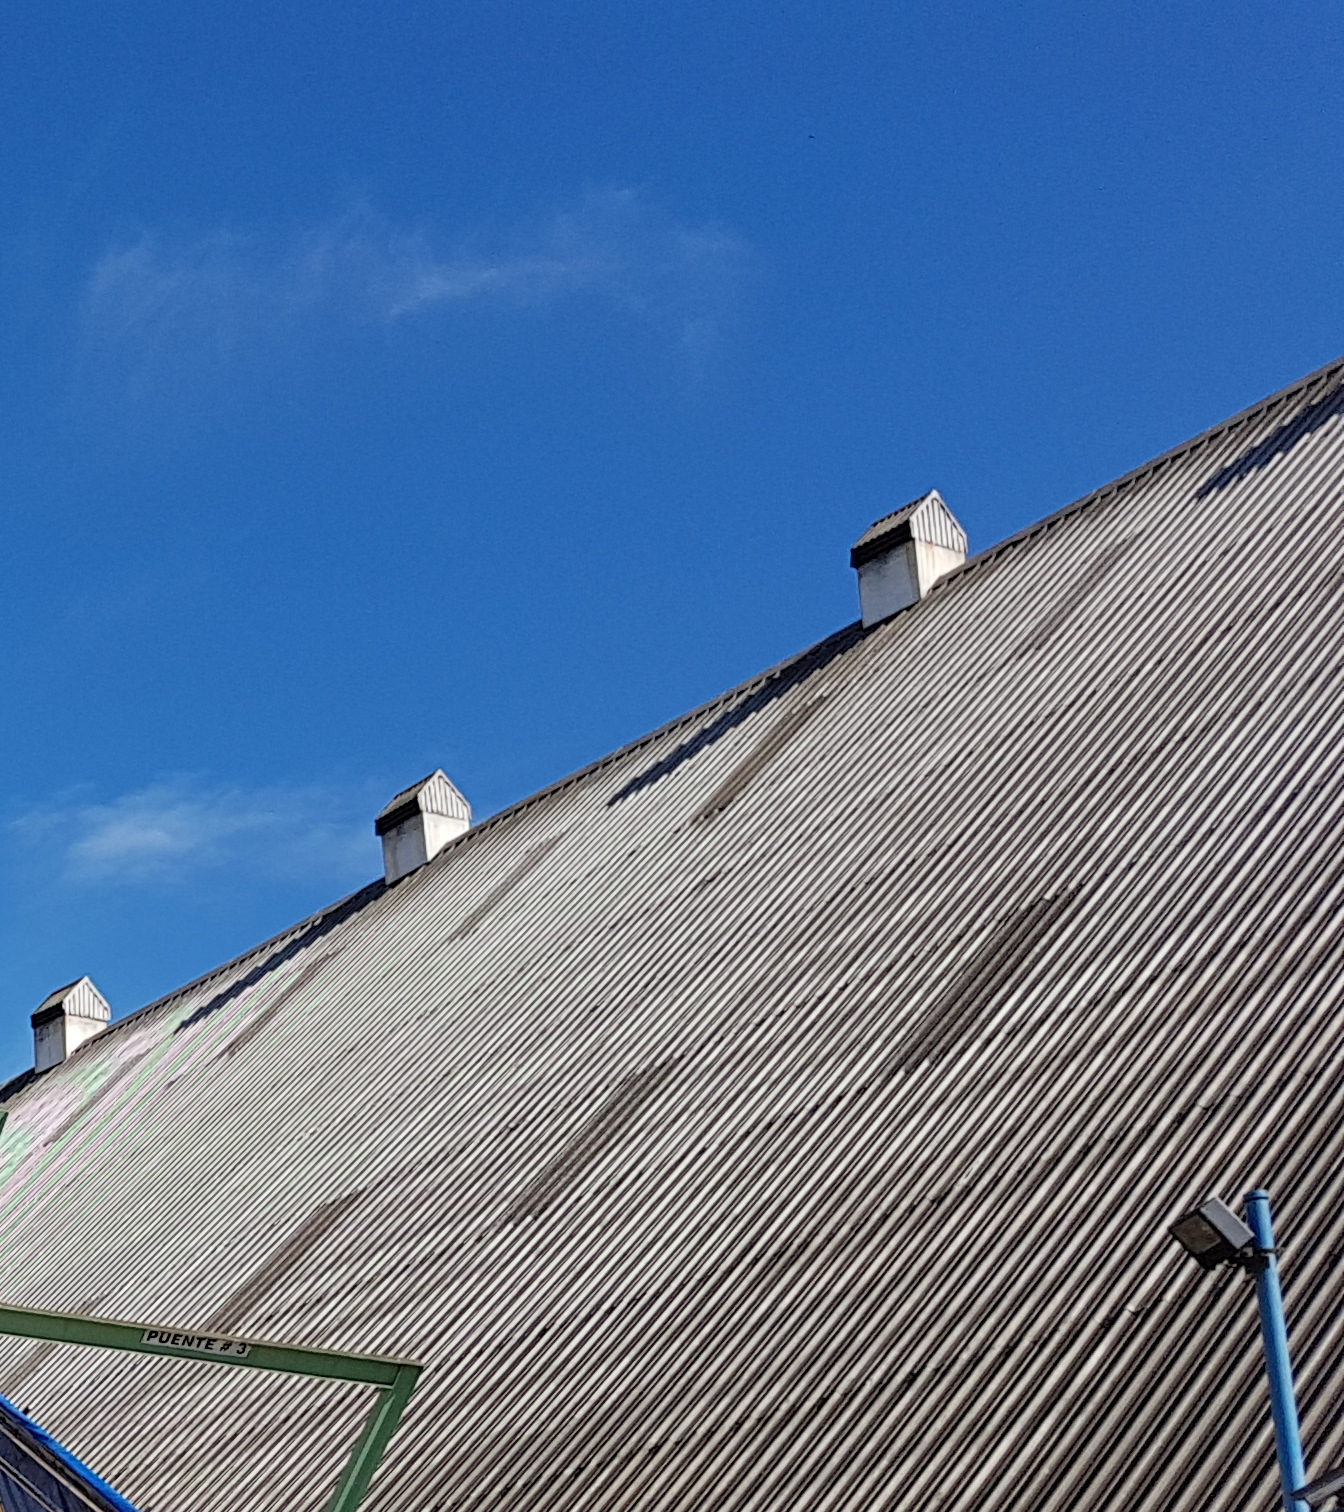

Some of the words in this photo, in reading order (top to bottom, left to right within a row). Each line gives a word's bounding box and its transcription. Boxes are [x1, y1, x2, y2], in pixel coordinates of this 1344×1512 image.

[147, 1330, 217, 1350] PUENTE
[220, 1341, 232, 1352] #
[236, 1342, 247, 1355] 3
